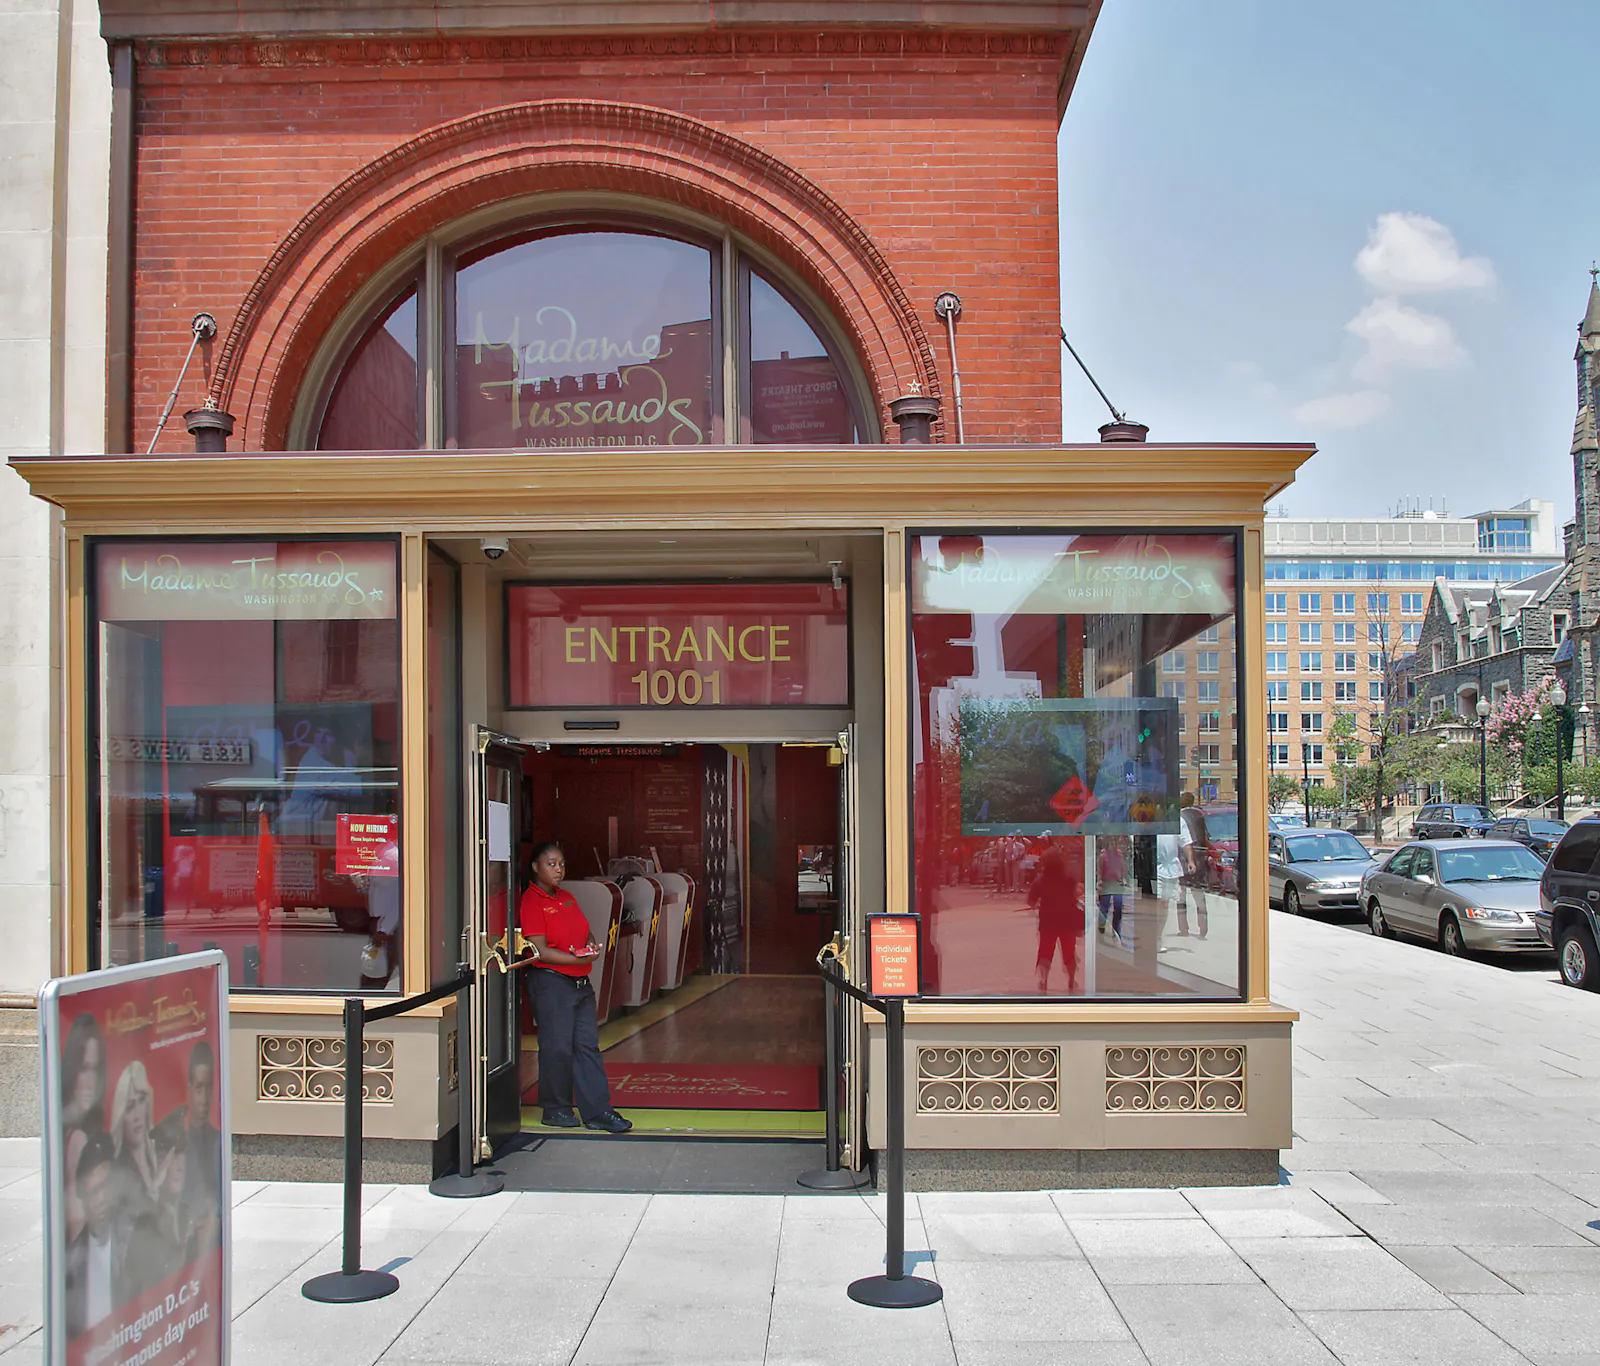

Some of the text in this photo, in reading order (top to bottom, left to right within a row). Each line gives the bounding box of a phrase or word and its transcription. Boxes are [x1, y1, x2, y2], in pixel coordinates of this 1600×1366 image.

[475, 306, 673, 372] Madame
[479, 365, 703, 446] Tussauds
[525, 435, 626, 449] WASHINGTON
[120, 550, 367, 606] Madame Tussauds
[1054, 544, 1188, 599] Tussauds
[243, 594, 317, 605] WASHINGTON
[1067, 587, 1142, 598] WASHINGTON
[565, 625, 791, 663] ENTRANCE
[631, 669, 721, 705] 1001
[350, 824, 388, 833] NOW HIRING
[876, 945, 912, 953] Individual
[880, 955, 907, 963] Tickets
[165, 1279, 200, 1315] D.C.'s
[164, 1320, 187, 1348] day
[187, 1301, 210, 1330] out
